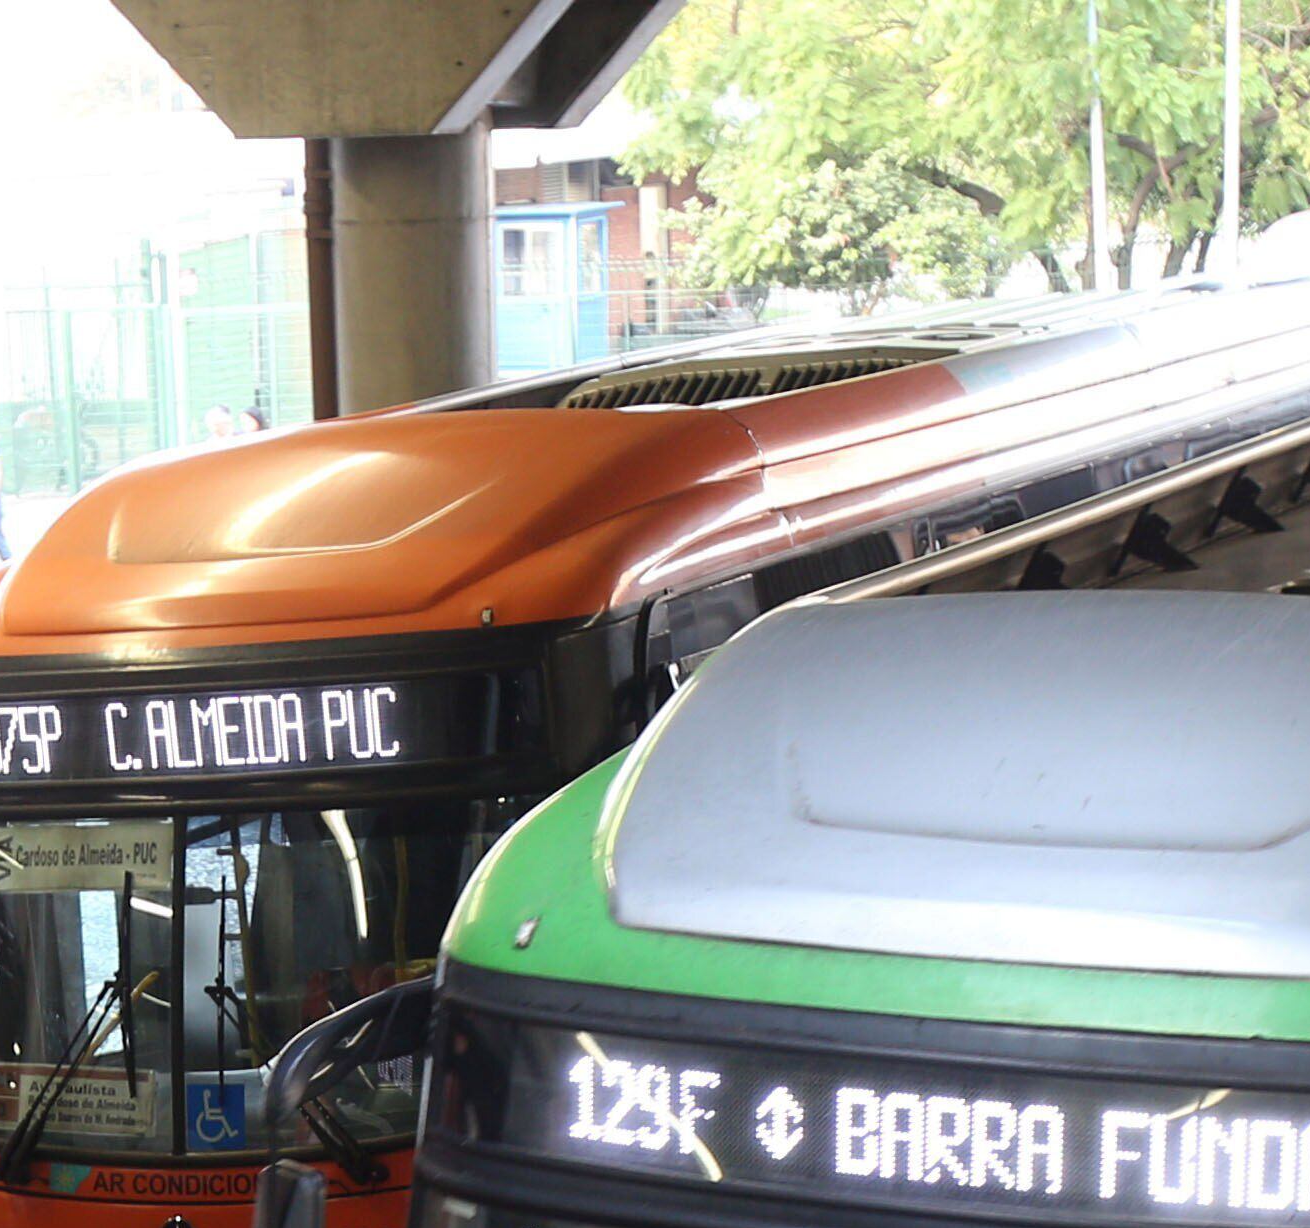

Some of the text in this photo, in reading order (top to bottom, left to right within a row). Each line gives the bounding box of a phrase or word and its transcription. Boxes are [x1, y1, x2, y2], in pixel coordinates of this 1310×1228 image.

[105, 694, 305, 772] C.ALMEIDA
[321, 687, 399, 759] PUC
[15, 843, 59, 868] Cardoso
[62, 846, 75, 867] de
[78, 843, 123, 866] Almeida
[133, 841, 157, 865] PUC
[834, 1088, 1063, 1195] BARRA
[93, 1172, 259, 1196] AR CONDICIO
